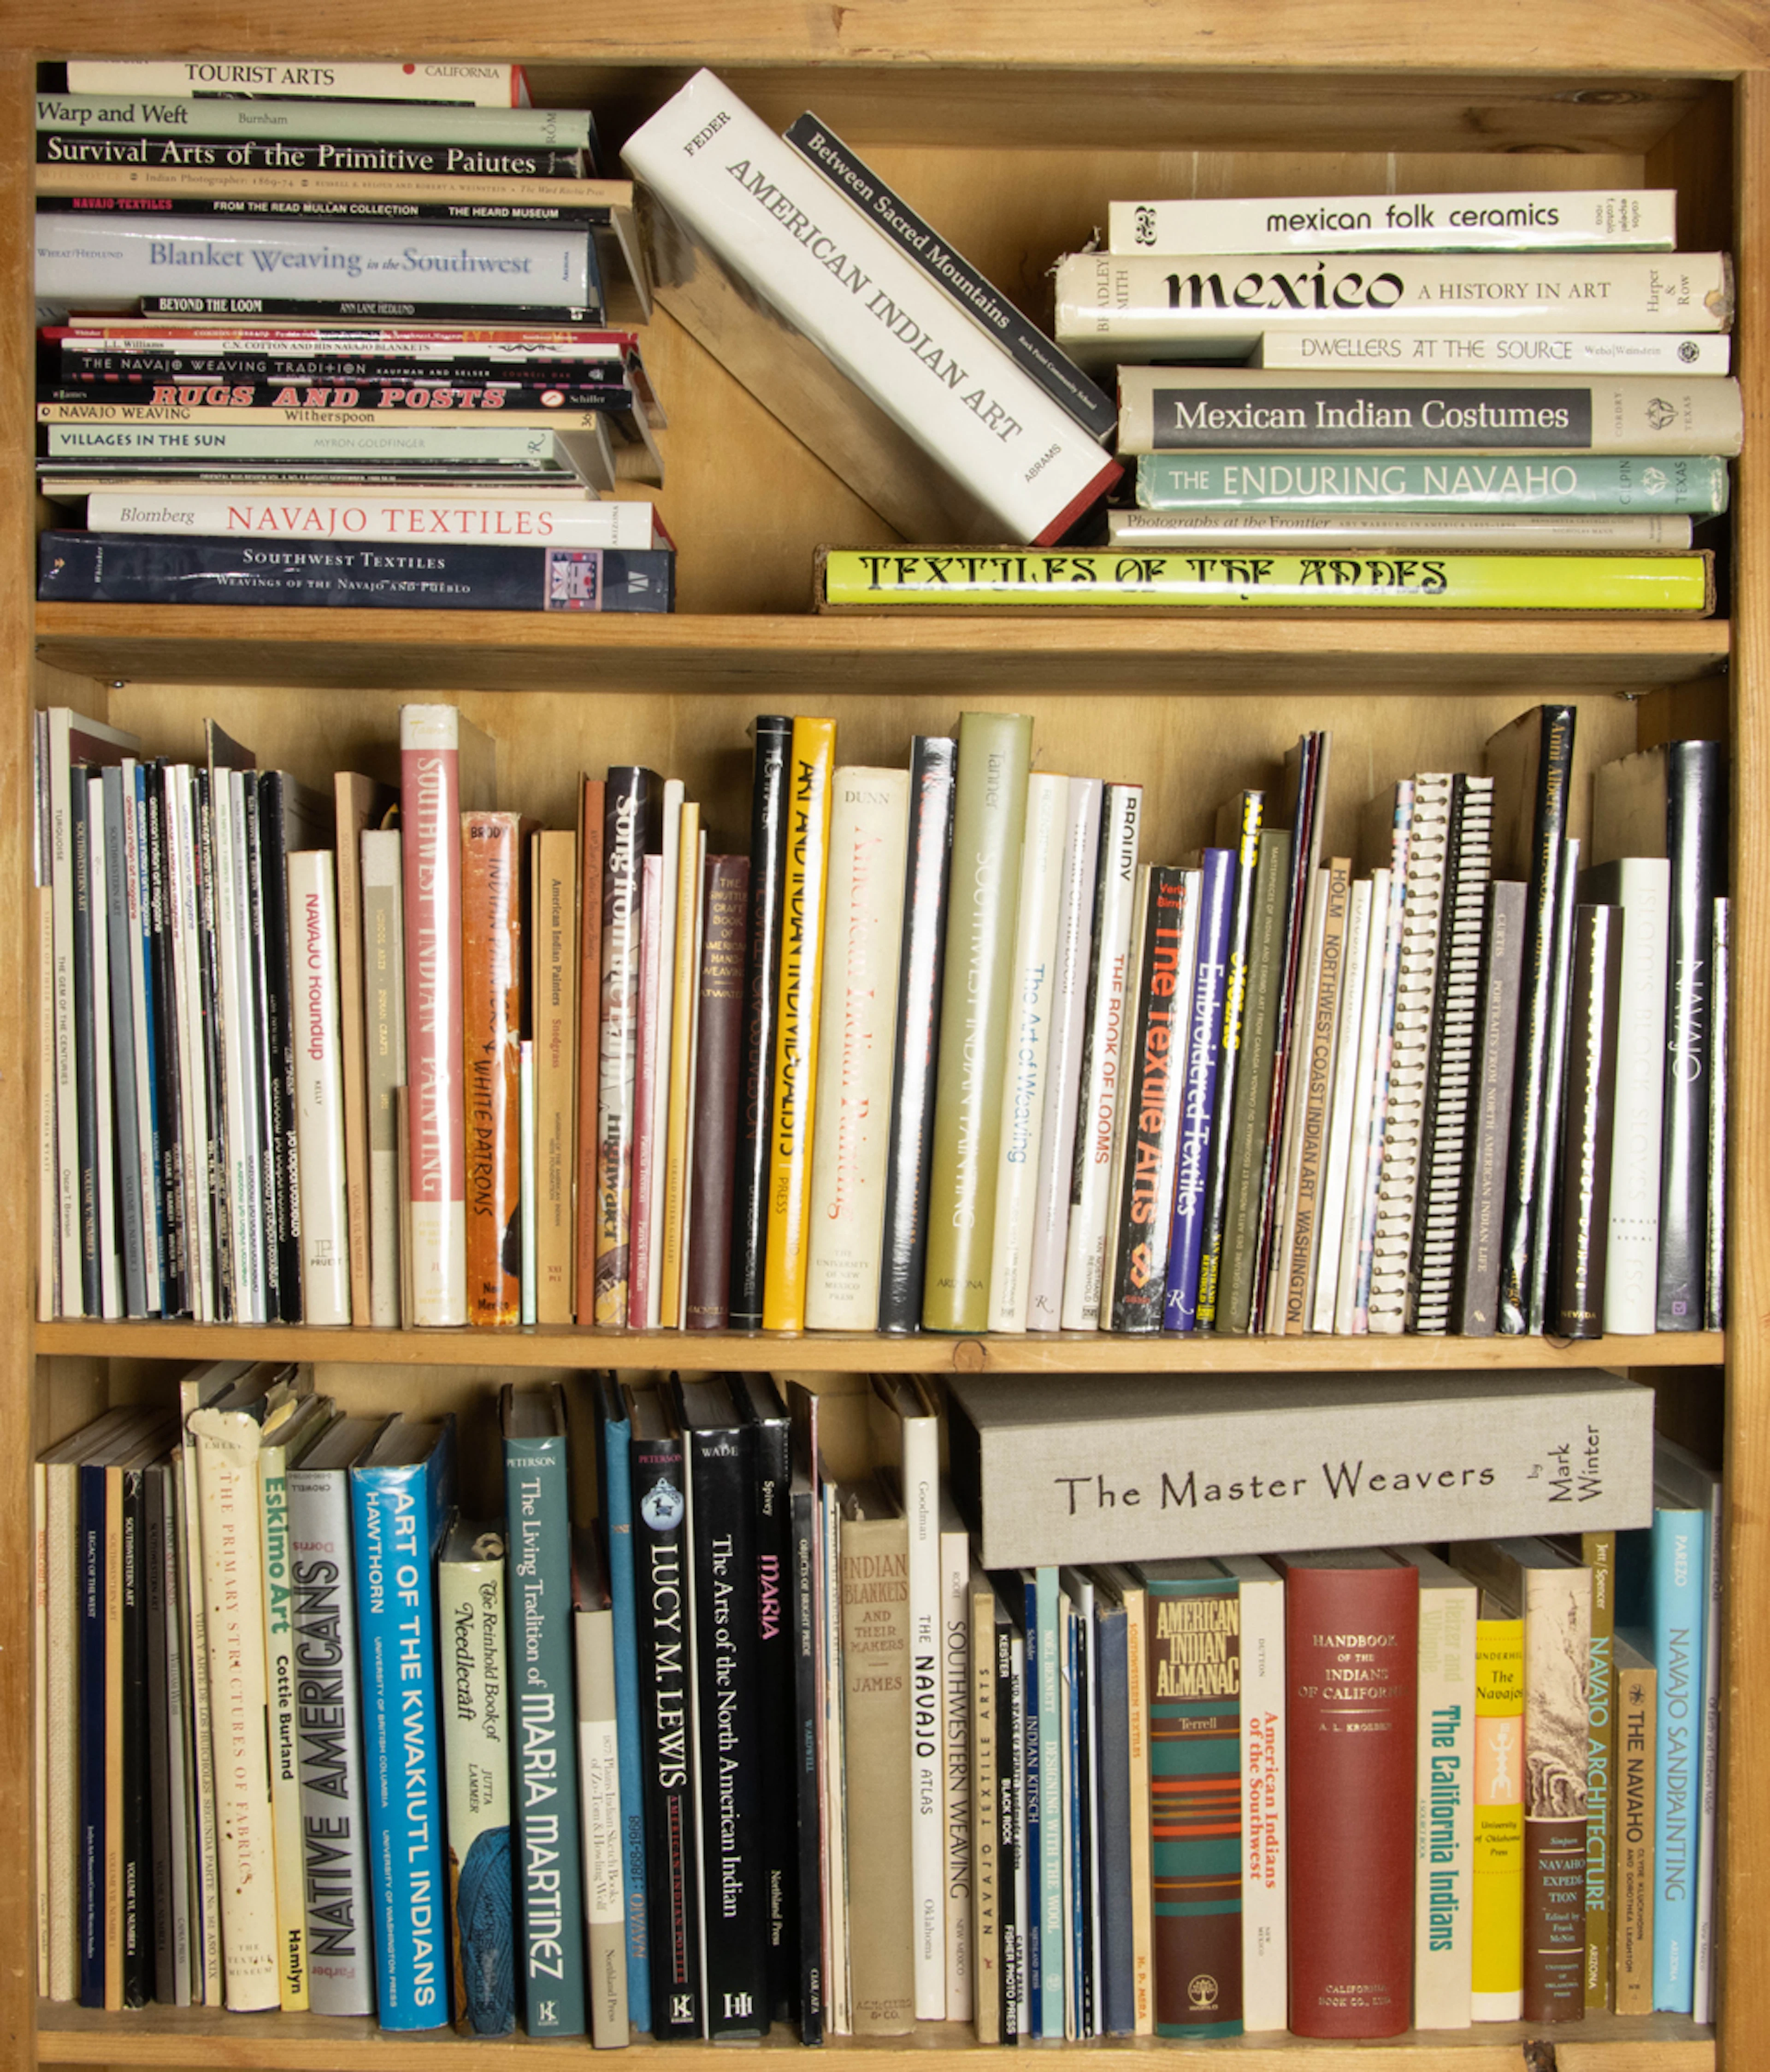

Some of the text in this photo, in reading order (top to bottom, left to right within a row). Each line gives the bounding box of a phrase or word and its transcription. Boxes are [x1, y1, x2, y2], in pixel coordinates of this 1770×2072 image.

[185, 64, 335, 85] TOURIST ARTS
[425, 66, 500, 79] CALIFORNIA
[37, 102, 189, 125] Warp and Weft
[238, 112, 288, 125] Burnham
[683, 111, 732, 157] FEDER
[47, 136, 537, 173] Survival Arts of the Primitive Paiutes
[808, 132, 1009, 329] Between Sacred Mountains
[1267, 203, 1559, 232] mexican folk ceramics
[150, 243, 531, 277] Blanket Weaving in the Southwest
[1161, 260, 1611, 309] mexico A HISTORY IN ART
[159, 298, 262, 313] BEYOND THE LOOM
[726, 159, 1023, 442] AMERICAN INDIAN ART
[1647, 270, 1664, 313] Harper
[1665, 284, 1676, 296] &
[1678, 275, 1689, 306] Row
[150, 386, 507, 408] RUGS AND POSTS
[570, 394, 605, 404] Schiller
[1174, 400, 1569, 429] Mexican Indian Costumes
[61, 434, 226, 447] VILLAGES IN THE SUN
[1024, 443, 1062, 483] ABRAMS
[1169, 466, 1577, 494] THE ENDURING NAVAHO
[1620, 460, 1632, 505] GILPIN
[1675, 461, 1687, 504] TEXAS
[120, 508, 194, 524] Blomberg
[227, 506, 553, 537] NAVAJO TEXTILES
[986, 750, 1005, 810] Tanner
[1546, 722, 1565, 815] Anni Albers
[846, 792, 889, 804] DUNN
[55, 809, 64, 861] TURQUOISE
[552, 879, 561, 1005] American Indian Painters
[305, 894, 324, 1060] NAVAJO Roundup
[550, 1018, 561, 1068] Snodgrass
[1008, 965, 1045, 1163] The Art of Weaving
[1095, 954, 1124, 1164] THE BOOK OF LOOMS
[1287, 870, 1346, 1323] HOLM NORTHWEST COAST INDIAN ART WASHINGTON
[1478, 913, 1506, 1271] CURTIS PORTRAITS FROM NORTH AMERICAN INDIAN LIFE
[473, 1060, 493, 1217] WHITE PATRONS
[777, 1177, 789, 1214] PRESS
[1054, 1461, 1494, 1516] The Master Weavers
[1548, 1442, 1571, 1503] Mark
[1577, 1425, 1602, 1501] Winter
[521, 1477, 540, 1515] The
[762, 1481, 774, 1516] Spivey
[266, 1478, 291, 1634] Eskimo Art
[366, 1491, 383, 1613] HAWTHORN
[517, 1520, 542, 1576] Living
[1674, 1535, 1687, 1587] PAREZO
[524, 1579, 544, 1661] Tradition
[1313, 1635, 1398, 1647] HANDBOOK
[454, 1602, 476, 1722] Needlecraft
[479, 1581, 500, 1742] The Reinhold Book of
[651, 1544, 687, 1787] LUCY M. LEWIS
[999, 1634, 1009, 1678] KEISTER
[1156, 1600, 1239, 1697] AMERICAN INDIAN ALMANAC
[528, 1667, 546, 1688] of
[277, 1655, 294, 1779] Cottie Burland
[713, 1535, 743, 1918] The Arts of the North American Indian
[915, 1615, 935, 1815] THE NAVAJO ATLAS
[1179, 1718, 1216, 1730] Terrell
[293, 1561, 355, 1956] NATIVE AMERICANS
[394, 1492, 435, 2007] ART OF THE KWAKIUTL INDIANS
[1585, 1637, 1610, 1913] NAVAJO ARCHITECTURE
[1664, 1629, 1690, 1901] NAVAJO SANDPAINTING
[1002, 1778, 1012, 1845] BLACK ROCK
[1250, 1718, 1264, 1880] of the Southwest
[1265, 1712, 1279, 1889] American Indians
[1430, 1705, 1461, 1950] The California Indians
[287, 1930, 302, 1994] Hamlyn
